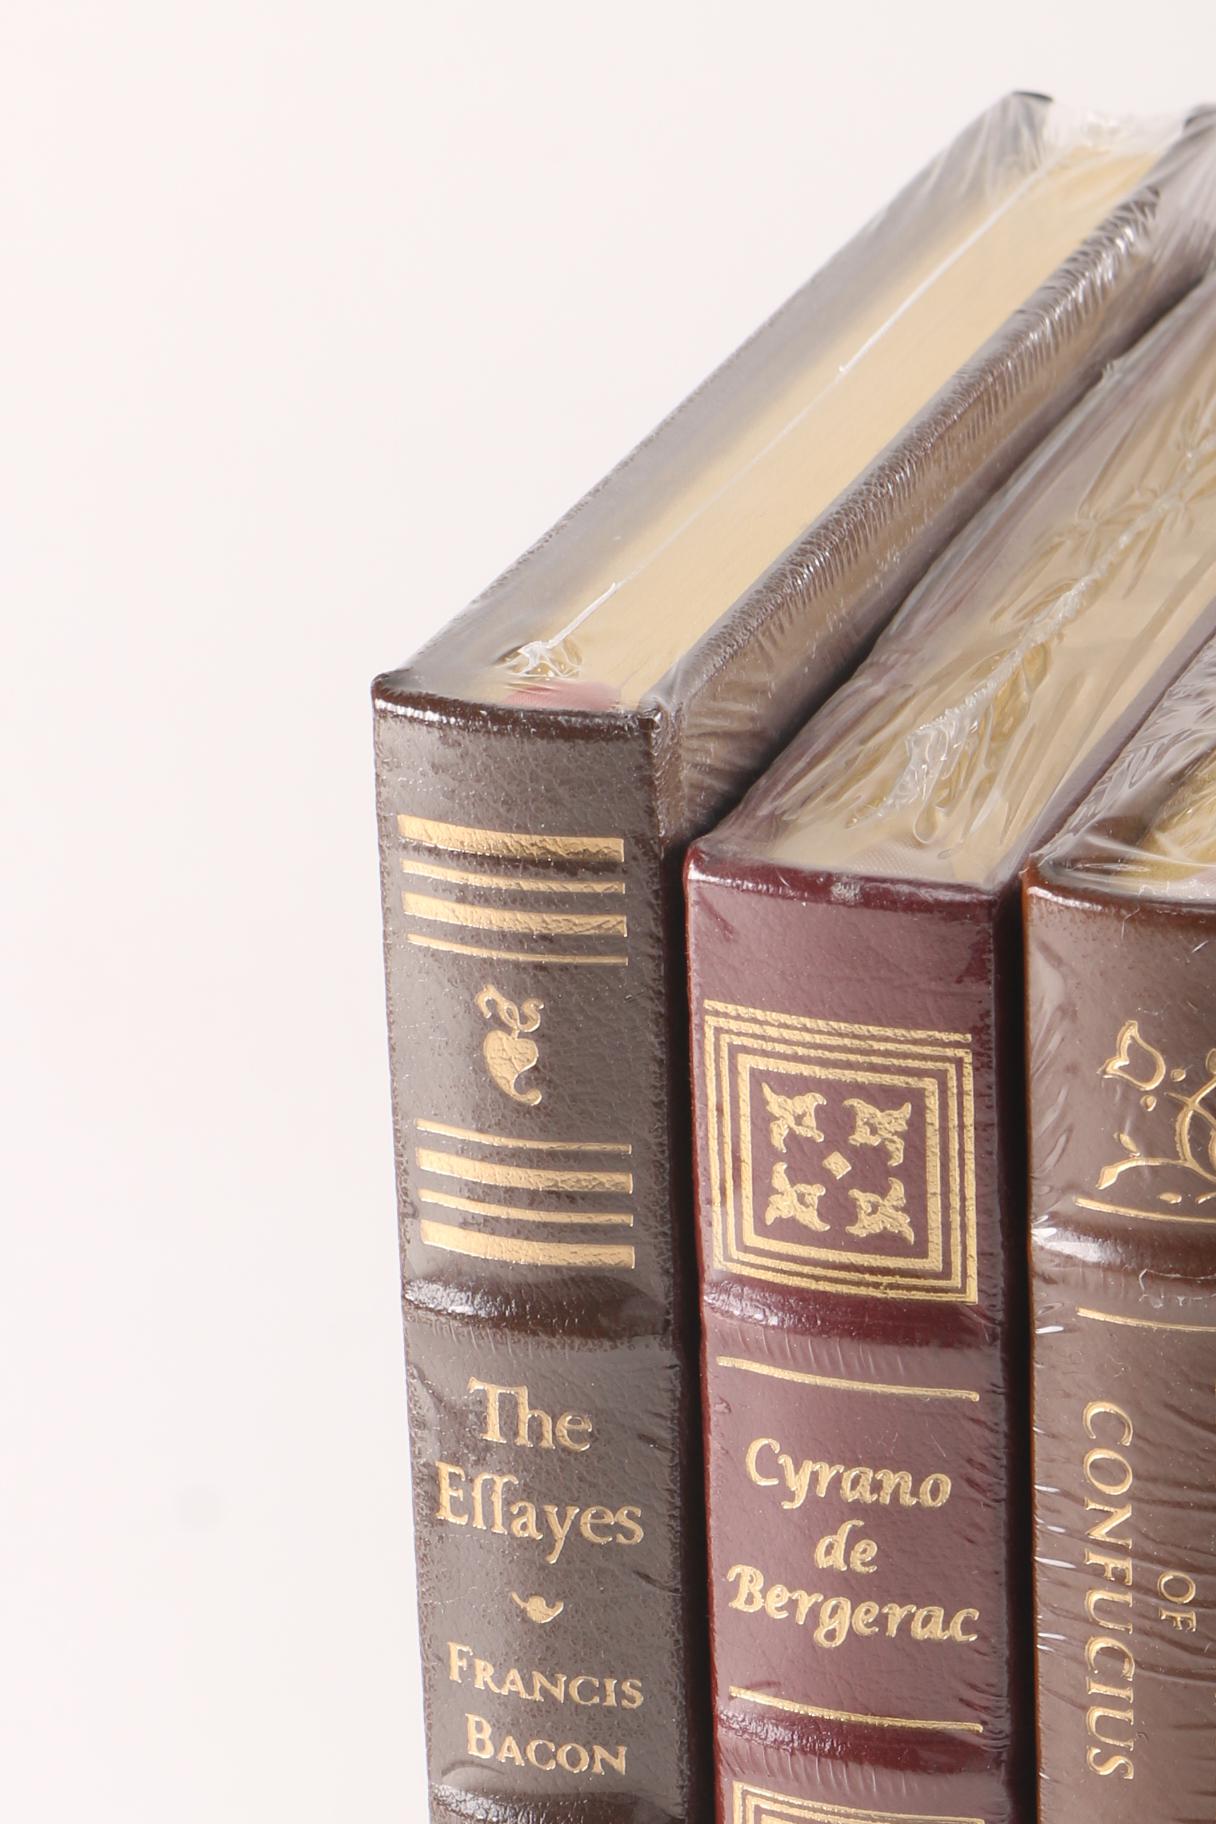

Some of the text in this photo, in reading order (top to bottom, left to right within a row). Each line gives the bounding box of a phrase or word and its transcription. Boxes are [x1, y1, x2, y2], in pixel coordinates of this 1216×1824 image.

[468, 1376, 594, 1453] The
[745, 1437, 953, 1509] Cyrano
[813, 1519, 879, 1574] de
[726, 1563, 980, 1649] Bergerac
[1083, 1401, 1136, 1780] CONFUCIUS
[1157, 1570, 1197, 1633] OF
[446, 1641, 645, 1710] FRANCIS
[464, 1713, 628, 1777] BACON
